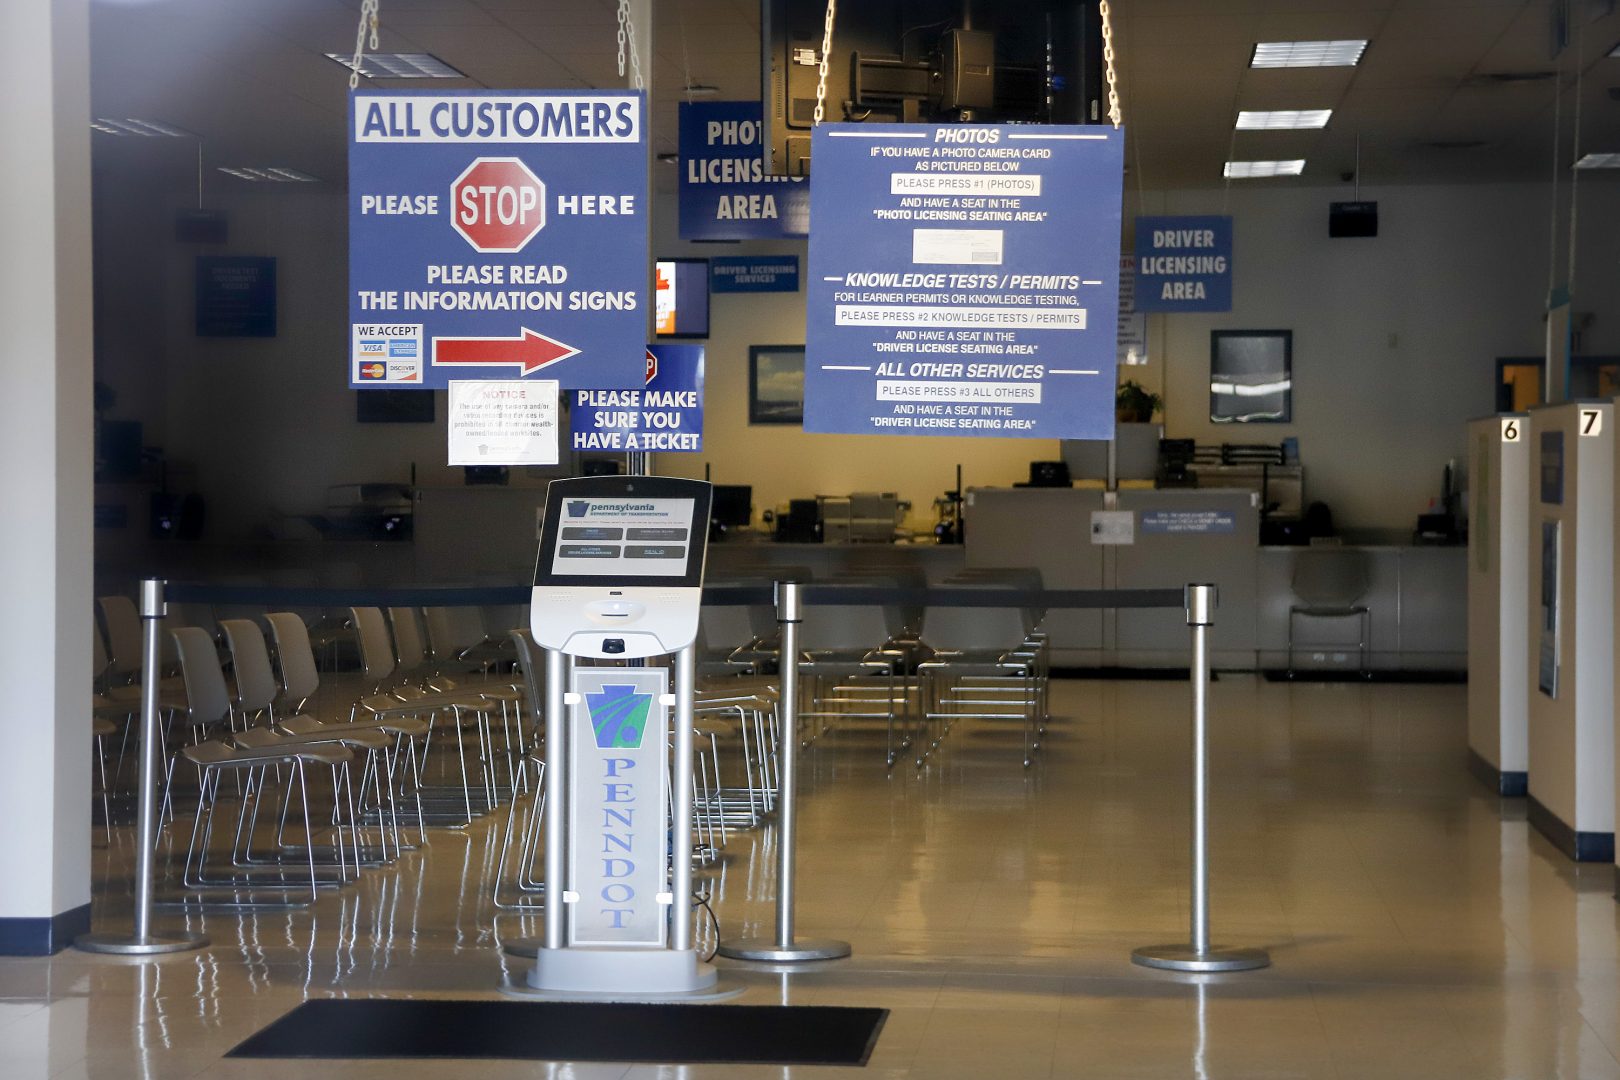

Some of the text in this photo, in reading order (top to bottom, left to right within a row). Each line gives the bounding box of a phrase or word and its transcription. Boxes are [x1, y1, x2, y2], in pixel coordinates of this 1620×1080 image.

[362, 102, 633, 137] ALL CUSTOMERS
[708, 121, 761, 145] PHOT
[935, 129, 1000, 143] PHOTOS
[871, 147, 1050, 158] IF YOU HAVE A PHOTO CAMERA CARD
[689, 158, 805, 183] LICENS
[915, 161, 1019, 171] AS PICTURED BELOW
[897, 179, 1034, 191] PLEASE PRESS #1 (PHOTOS)
[362, 196, 438, 214] PLEASE
[460, 185, 537, 225] STOP
[558, 196, 634, 214] HERE
[717, 195, 777, 219] AREA
[900, 198, 1020, 208] AND HAVE A SEAT IN THE
[873, 210, 1047, 221] "PHOTO LICENSING SEATING AREA"
[1154, 230, 1214, 248] DRIVER
[714, 265, 796, 274] DRIVER LICENSING
[1142, 256, 1226, 274] LICENSING
[428, 265, 567, 284] PLEASE READ
[735, 274, 775, 283] SERVICES
[846, 273, 1079, 289] KNOWLEDGE TESTS / PERMITS
[1162, 282, 1205, 299] AREA
[358, 291, 636, 310] THE INFORMATION SIGNS
[835, 292, 1079, 306] FOR LEARNER PERMITS OR KNOWLEDGE TESTING,
[842, 311, 1079, 324] PLEASE PRESS #2 KNOWLEDGE TESTS / PERMITS
[358, 327, 417, 335] WE ACCEPT
[896, 331, 1015, 341] AND HAVE A SEAT IN THE
[873, 343, 1038, 354] "DRIVER LICENSE SEATING AREA"
[875, 363, 1044, 379] ALL OTHER SERVICES
[483, 391, 526, 399] NOTICE
[578, 391, 697, 407] PLEASE MAKE
[883, 386, 1034, 398] PLEASE PRESS #3 ALL OTHERS
[894, 405, 1012, 416] AND HAVE A SEAT IN THE
[594, 412, 680, 428] SURE YOU
[871, 417, 1035, 429] "DRIVER LICENSE SEATING AREA"
[1584, 412, 1597, 434] 7
[1505, 421, 1517, 439] 6
[574, 433, 699, 449] HAVE A TICKET
[591, 504, 655, 512] pennsylvania
[600, 758, 636, 929] PENNDOT
